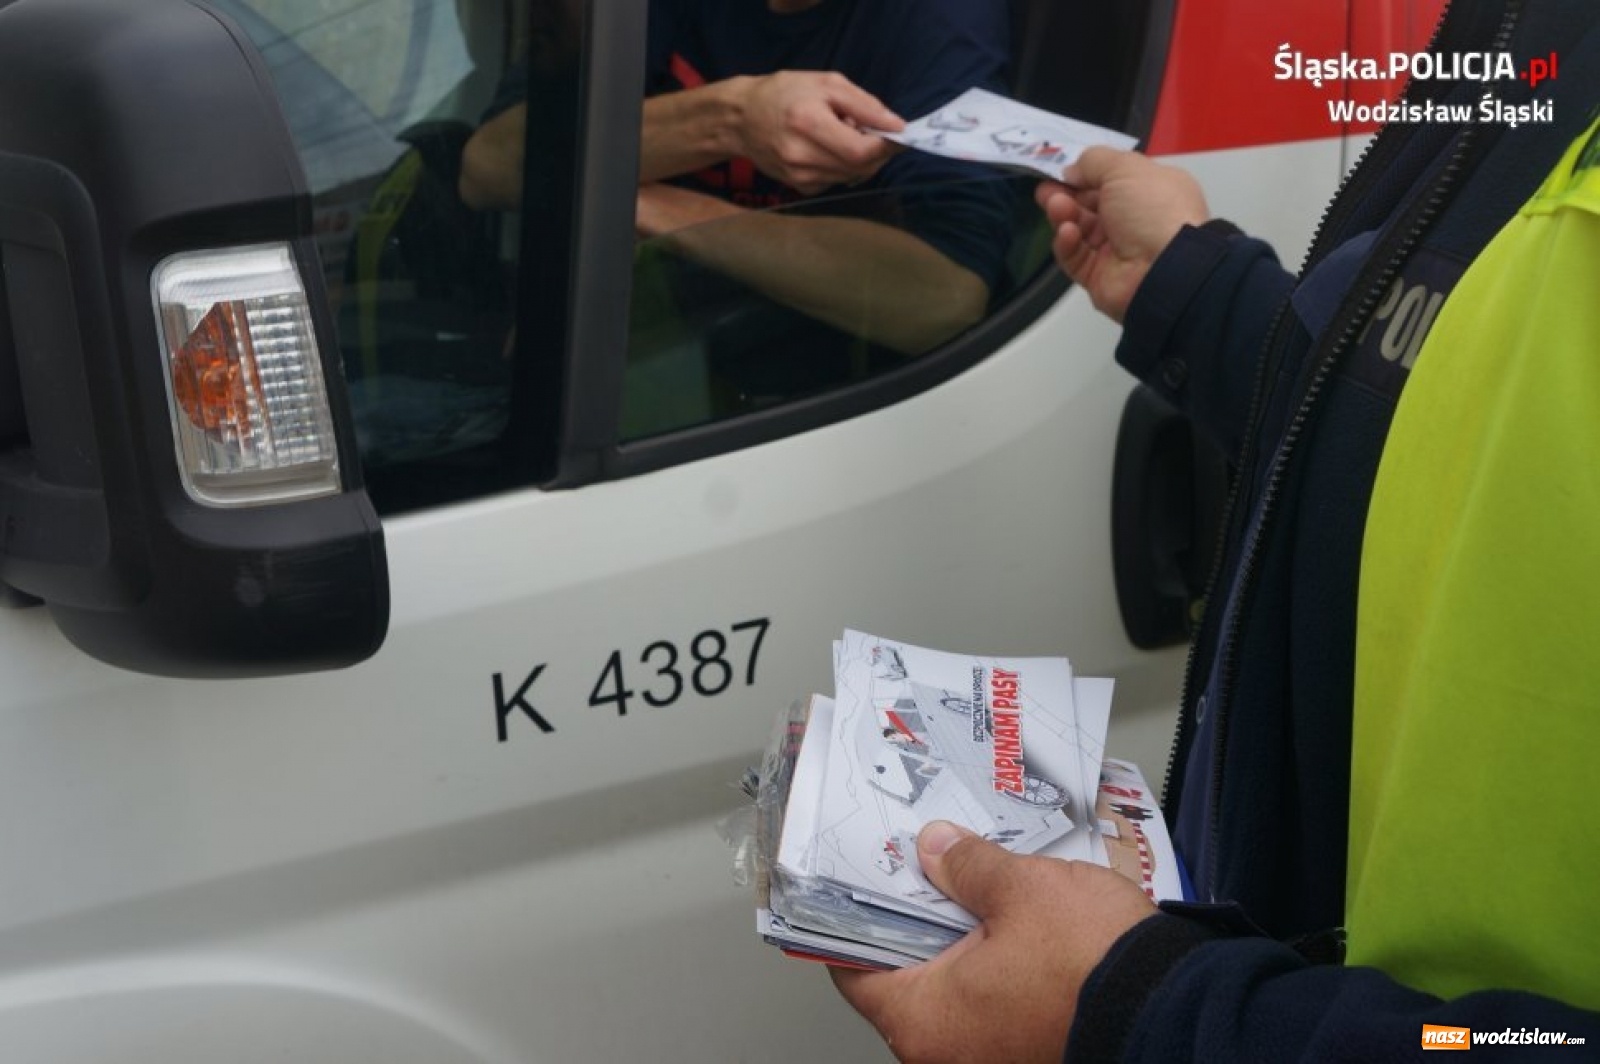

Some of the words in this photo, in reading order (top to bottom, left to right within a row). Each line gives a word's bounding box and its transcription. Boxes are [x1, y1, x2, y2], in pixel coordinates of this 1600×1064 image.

[492, 662, 556, 742] K
[588, 617, 770, 716] 4387
[991, 667, 1020, 710] PASY
[993, 711, 1024, 794] ZAPINAM
